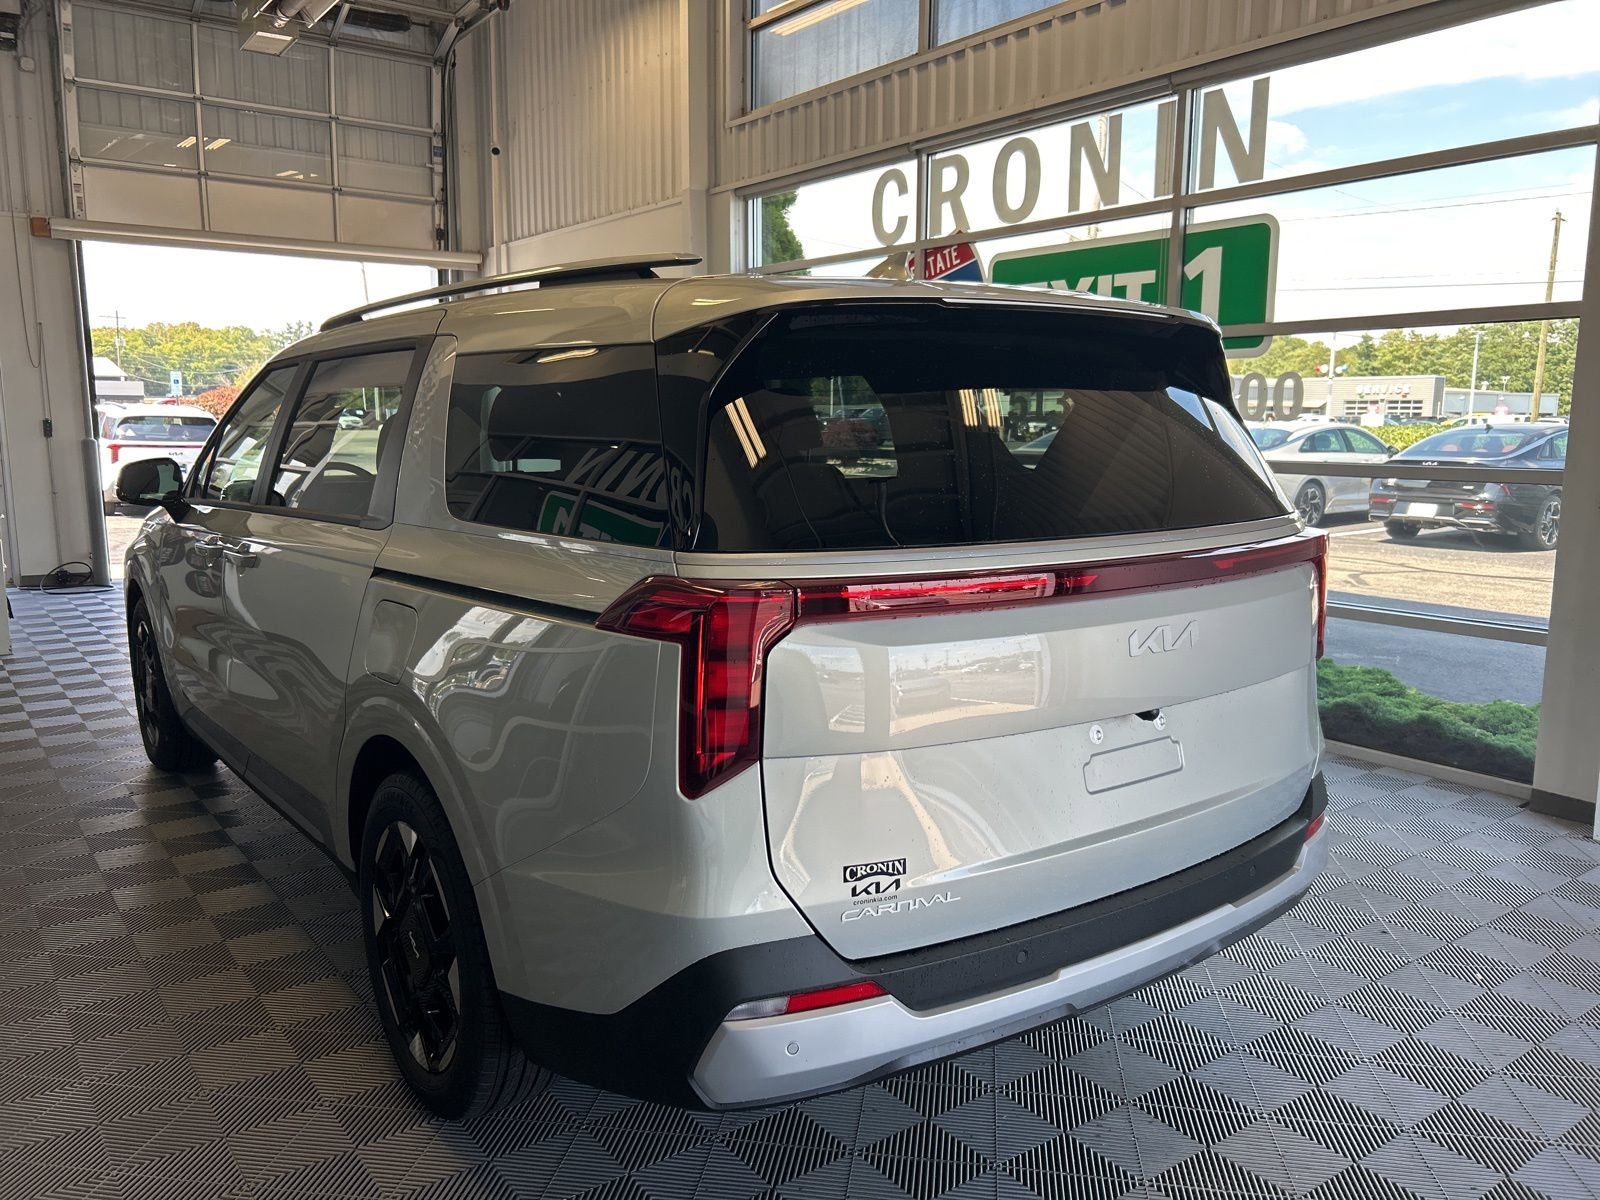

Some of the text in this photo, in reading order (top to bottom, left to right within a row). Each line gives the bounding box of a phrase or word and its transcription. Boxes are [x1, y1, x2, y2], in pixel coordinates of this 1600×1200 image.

[872, 76, 1271, 246] CRONIN
[1184, 246, 1222, 323] 1
[1128, 619, 1200, 657] KIA
[845, 858, 905, 882] CRONIN
[851, 878, 900, 897] KIA
[853, 894, 898, 906] croninkia.com
[841, 892, 961, 923] CARNIVAL
